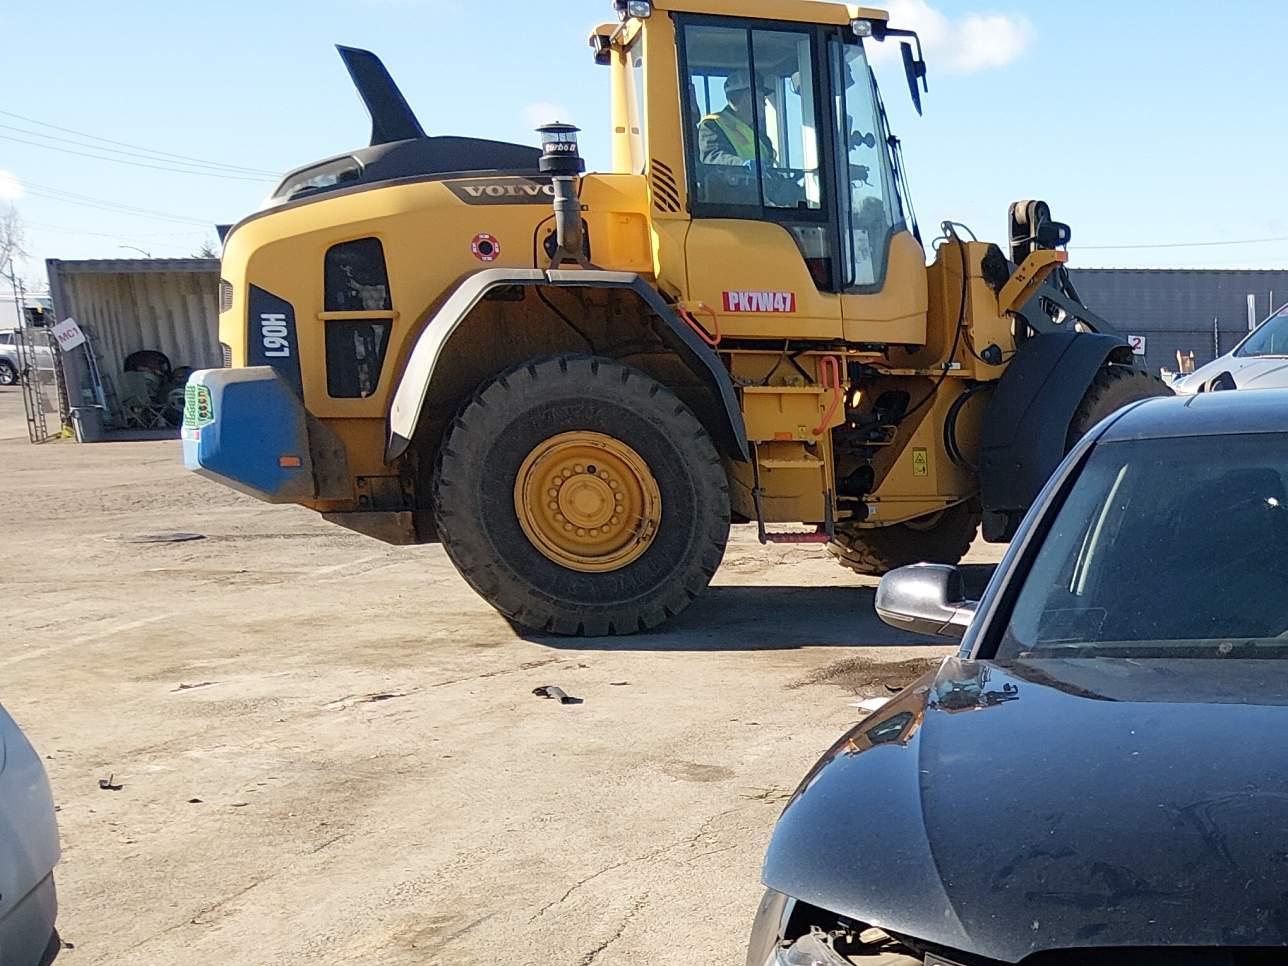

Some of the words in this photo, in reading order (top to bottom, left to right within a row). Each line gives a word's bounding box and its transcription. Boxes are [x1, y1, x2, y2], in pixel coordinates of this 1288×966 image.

[728, 291, 792, 312] PK7W47
[260, 313, 290, 357] L90H
[1132, 337, 1141, 350] 2
